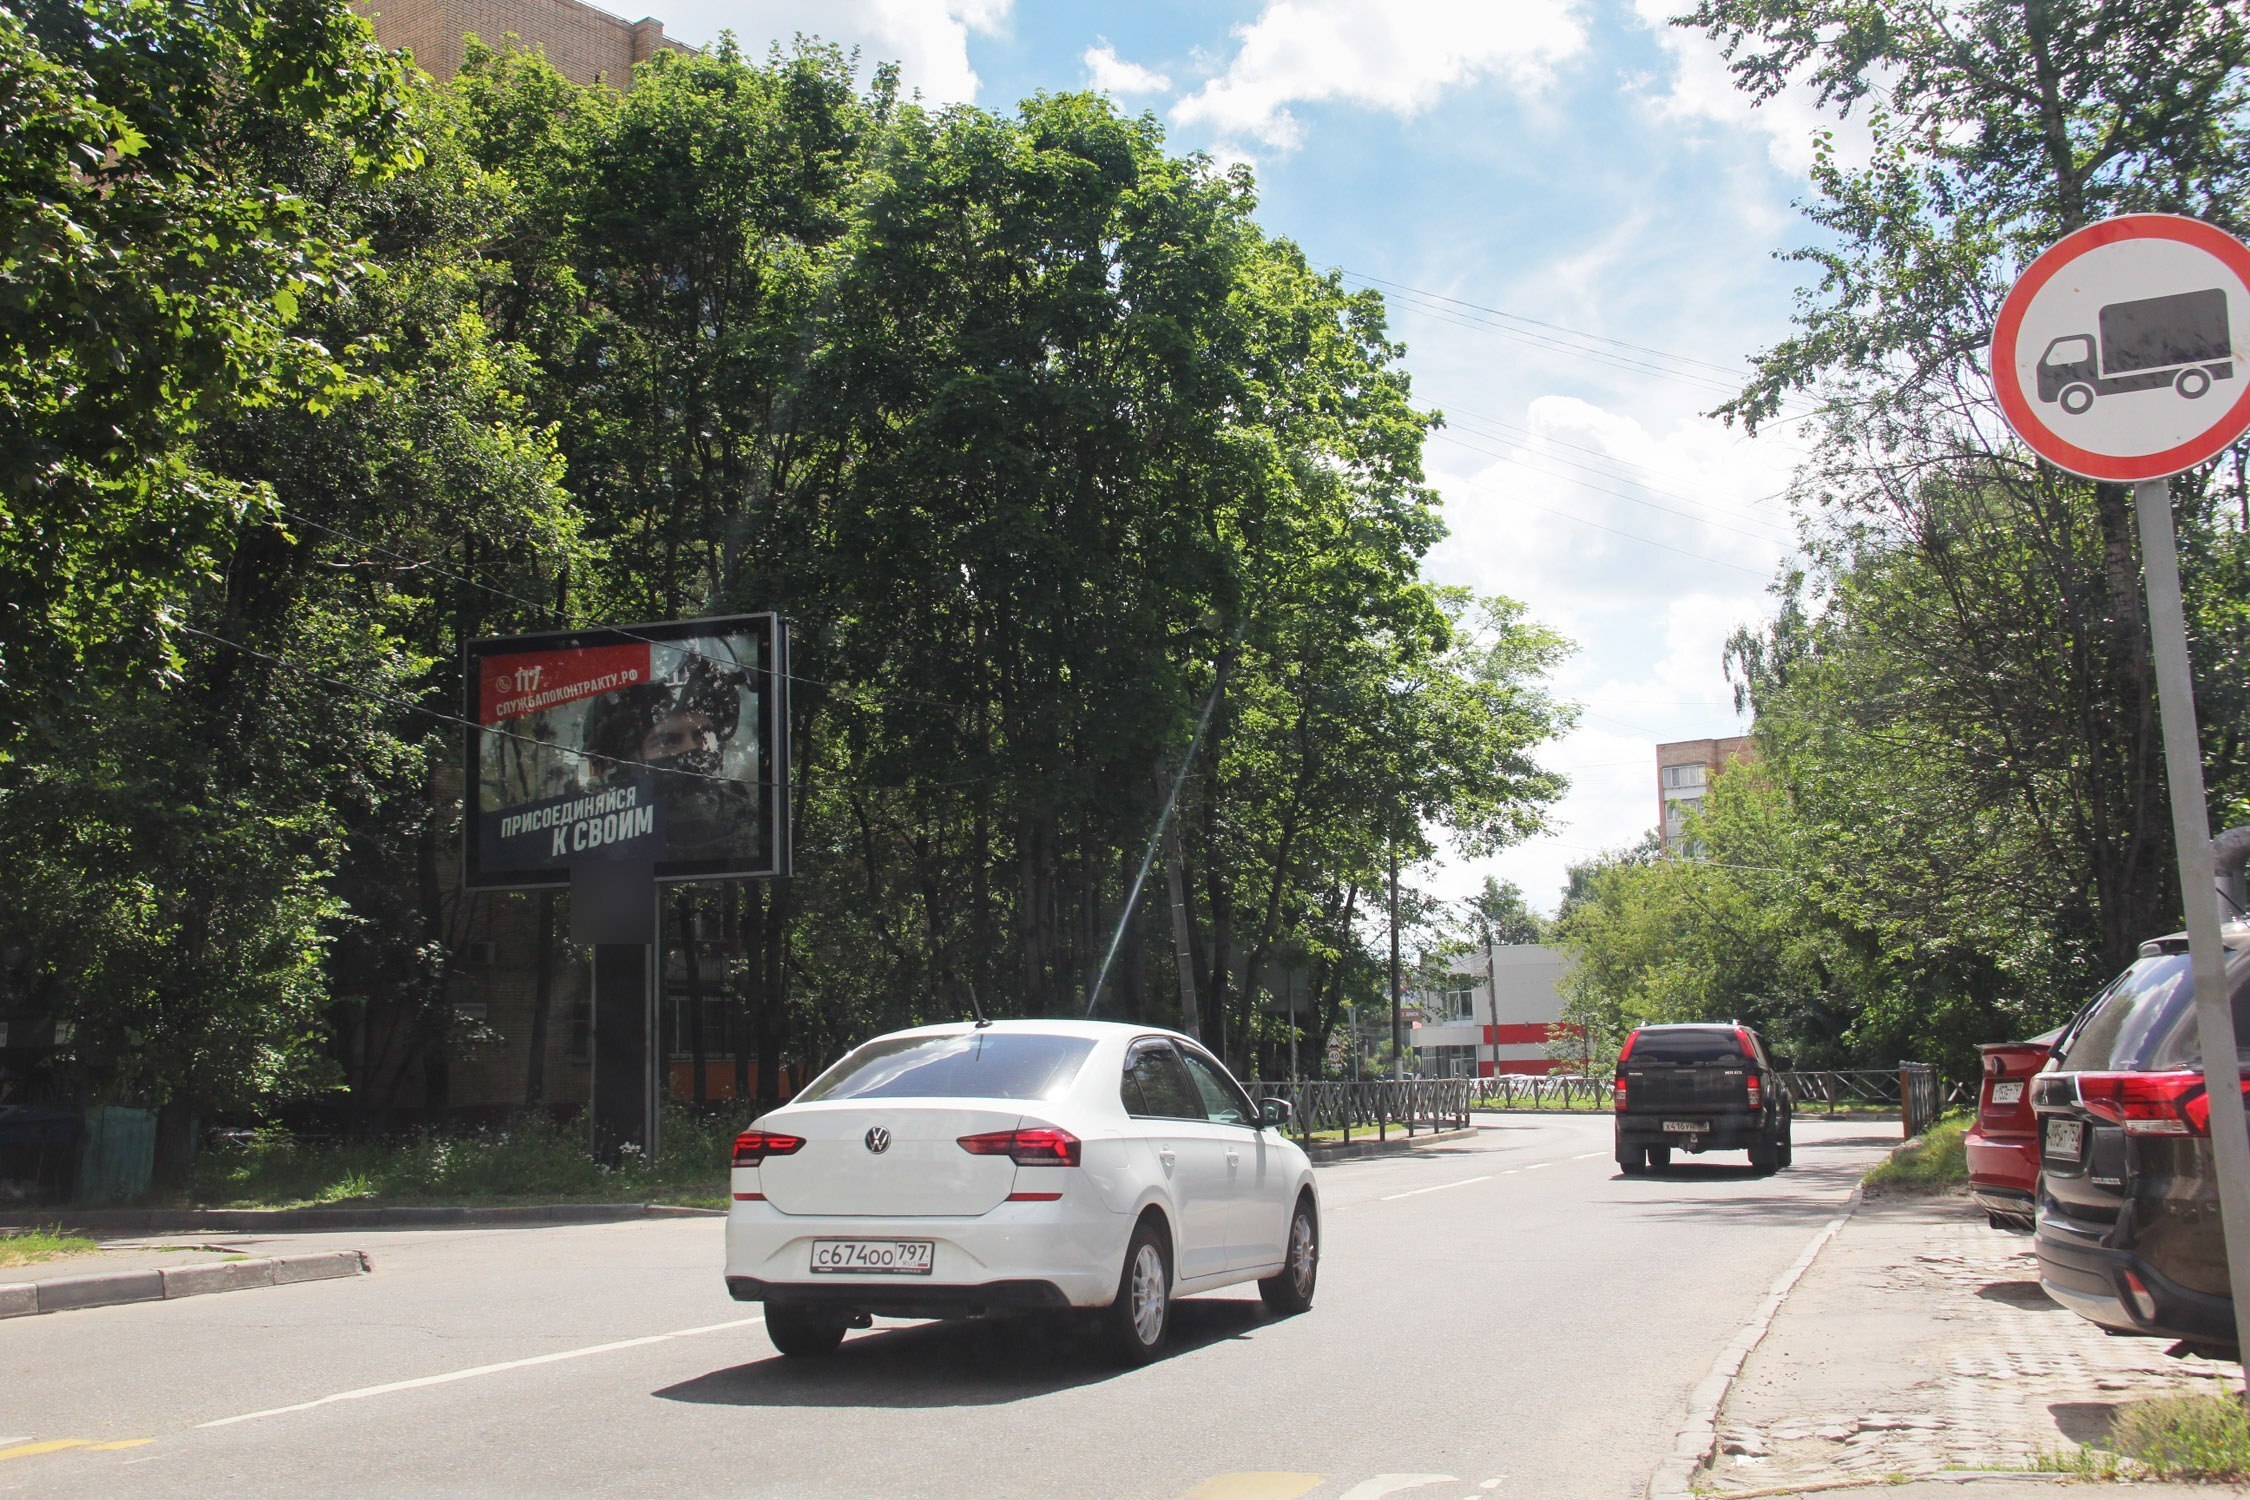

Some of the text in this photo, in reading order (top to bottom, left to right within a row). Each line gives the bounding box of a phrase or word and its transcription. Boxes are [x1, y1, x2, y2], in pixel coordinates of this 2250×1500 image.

[496, 668, 638, 716] СЛУЖБАПОКОНТРАКТУ.РФ
[514, 665, 541, 692] 117
[501, 785, 636, 838] ПРИСОЕДИНЯЙСЯ
[552, 805, 654, 856] К СВОИМ
[898, 1244, 927, 1260] 797
